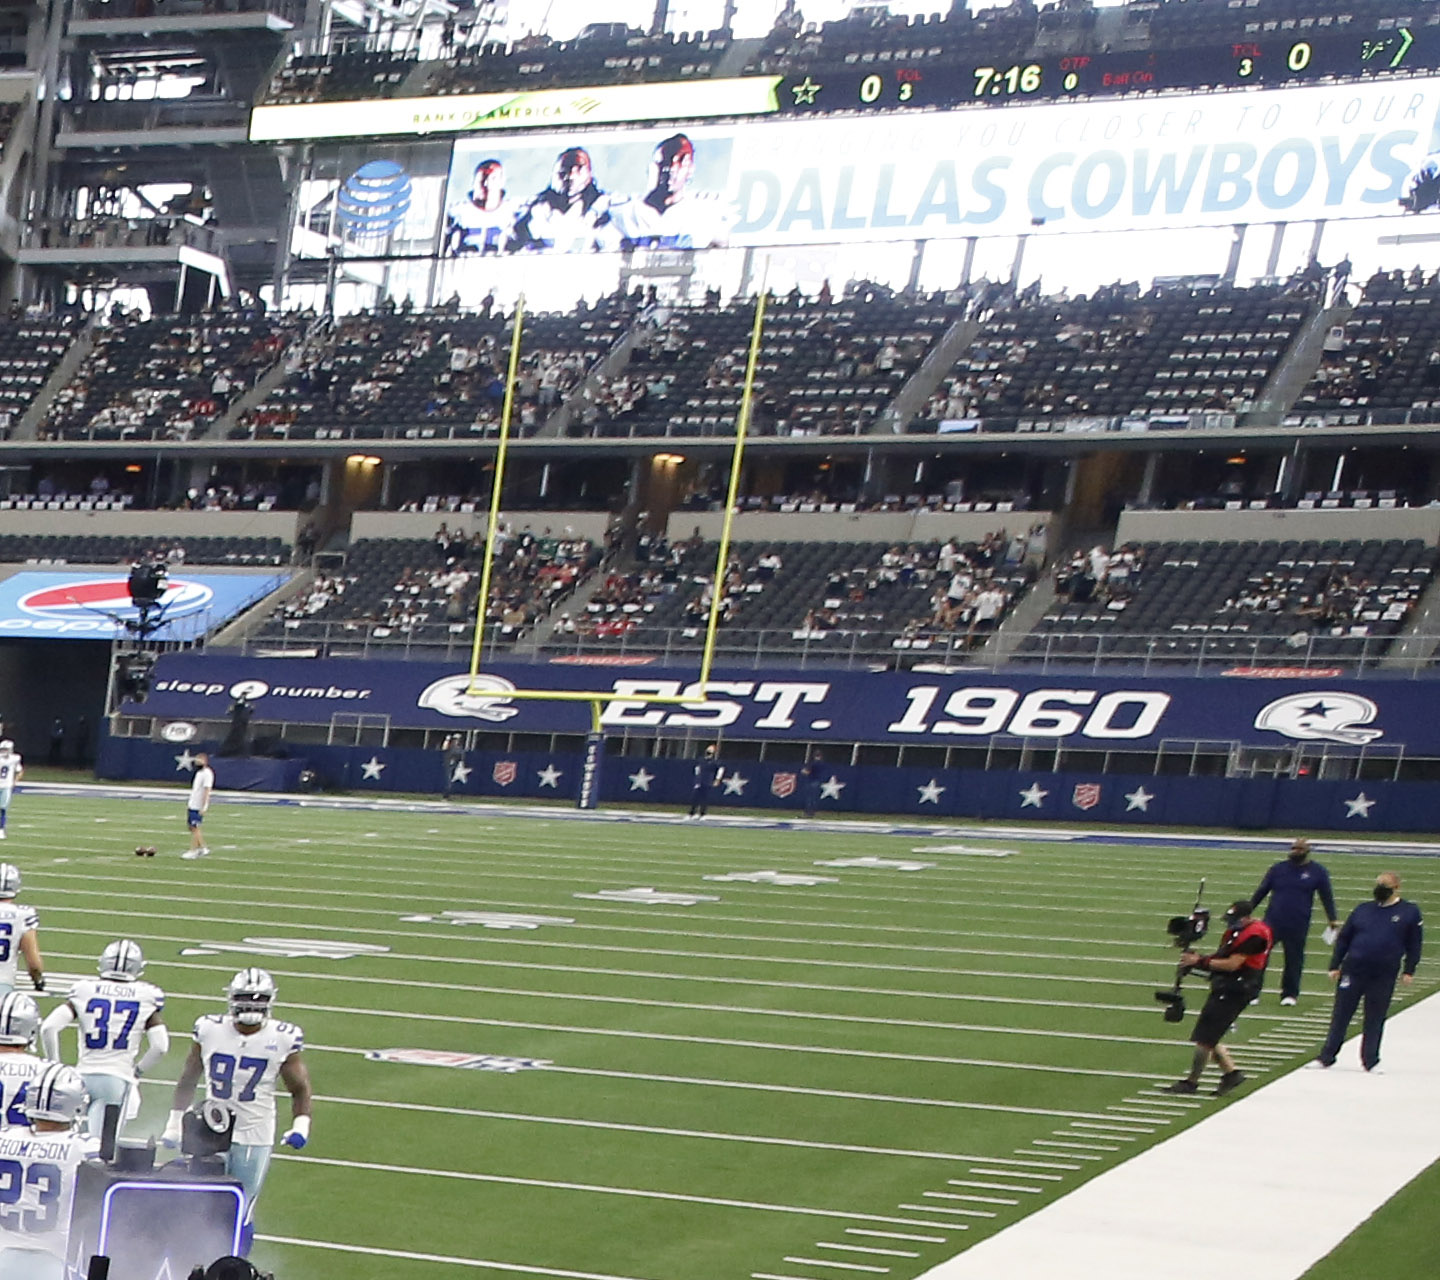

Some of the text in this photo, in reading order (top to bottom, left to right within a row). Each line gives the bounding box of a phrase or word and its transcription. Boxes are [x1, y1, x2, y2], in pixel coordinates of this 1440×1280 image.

[1238, 58, 1253, 76] 3
[1287, 43, 1312, 71] 0
[860, 76, 881, 103] 0
[899, 83, 913, 100] 3
[973, 65, 1041, 97] 7:16
[1064, 73, 1078, 91] 0
[484, 105, 562, 121] AMERICA
[957, 121, 1026, 148] YOU
[1055, 110, 1202, 143] CLOSER
[1237, 104, 1281, 132] TO
[1316, 94, 1425, 126] YOUR
[730, 130, 1419, 234] DALLAS COWBOYS
[155, 680, 372, 700] sleep number
[600, 679, 1172, 738] EST. 1960
[94, 983, 137, 998] WILSON
[85, 998, 141, 1050] 37
[208, 1053, 270, 1102] 97
